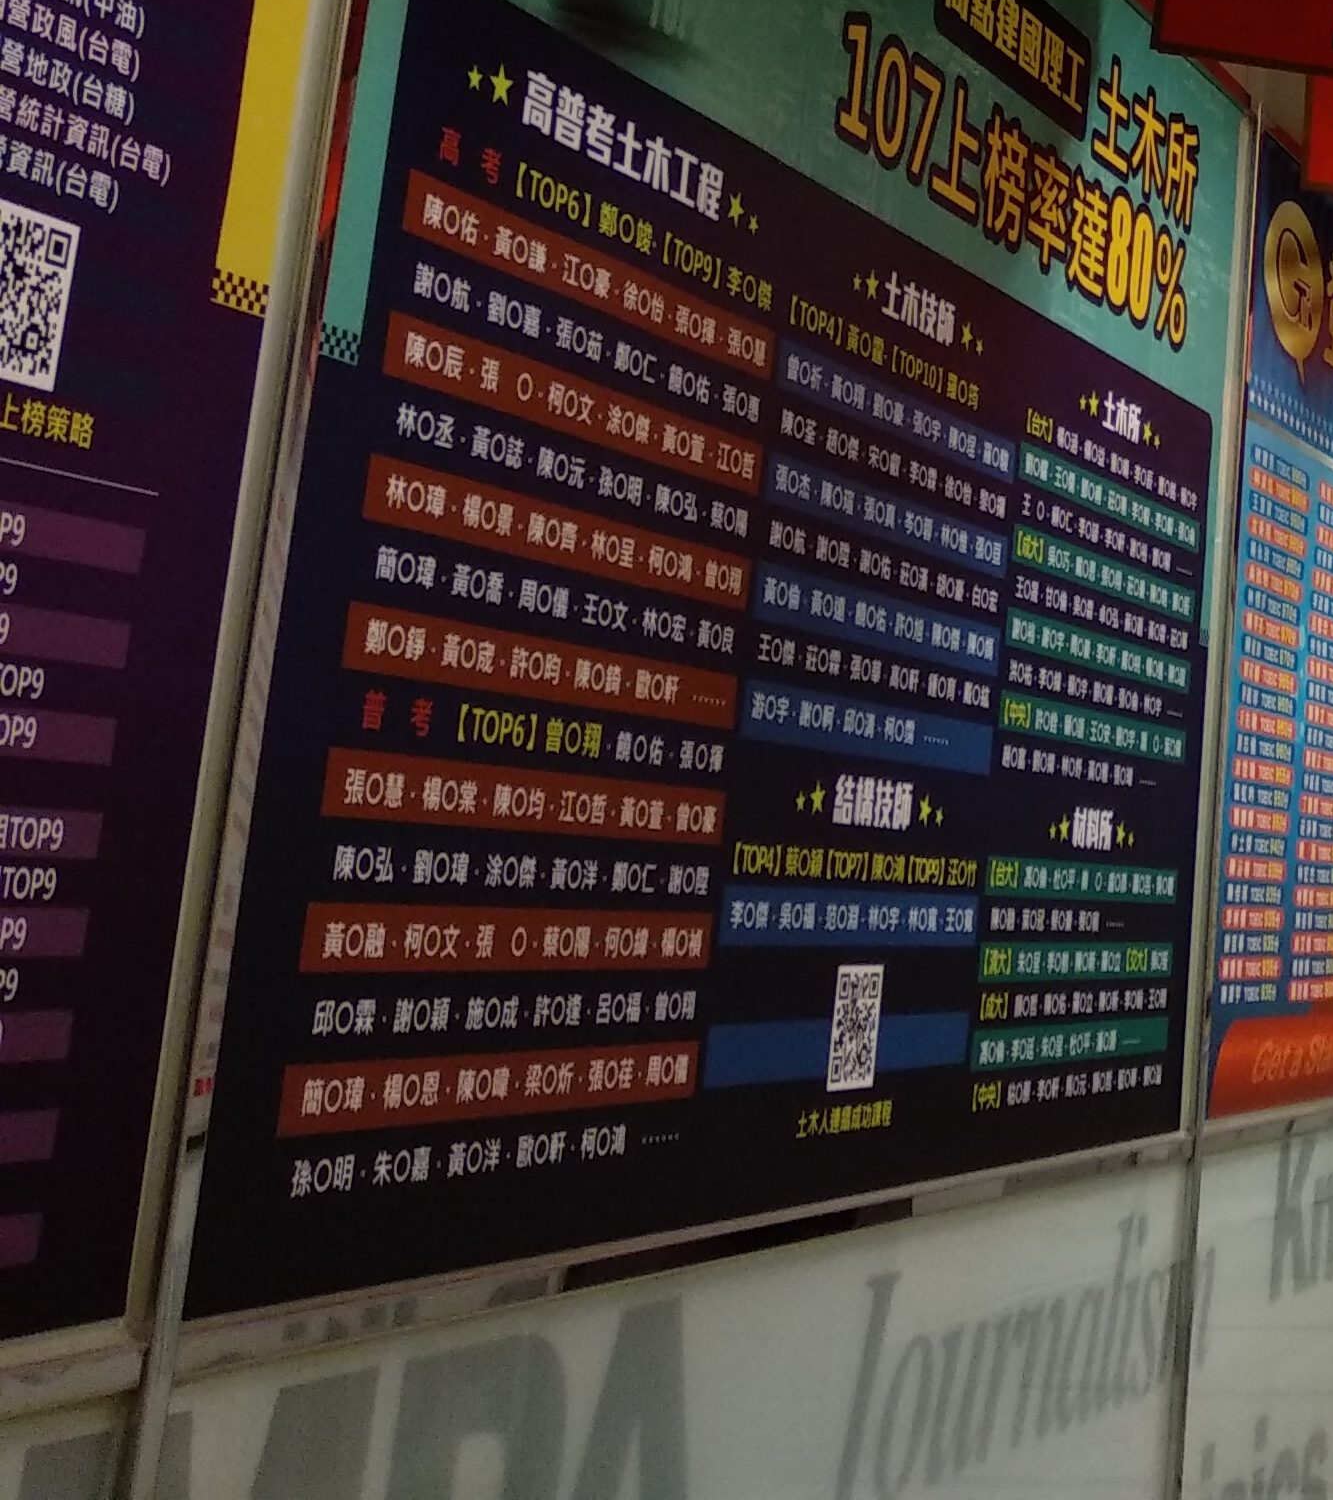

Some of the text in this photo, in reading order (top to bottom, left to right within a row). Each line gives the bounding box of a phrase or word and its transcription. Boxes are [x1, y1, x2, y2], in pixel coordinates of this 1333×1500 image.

[520, 68, 725, 222] 高普考土木工程
[1094, 65, 1199, 226] 土木所
[881, 270, 957, 347] 土木技師
